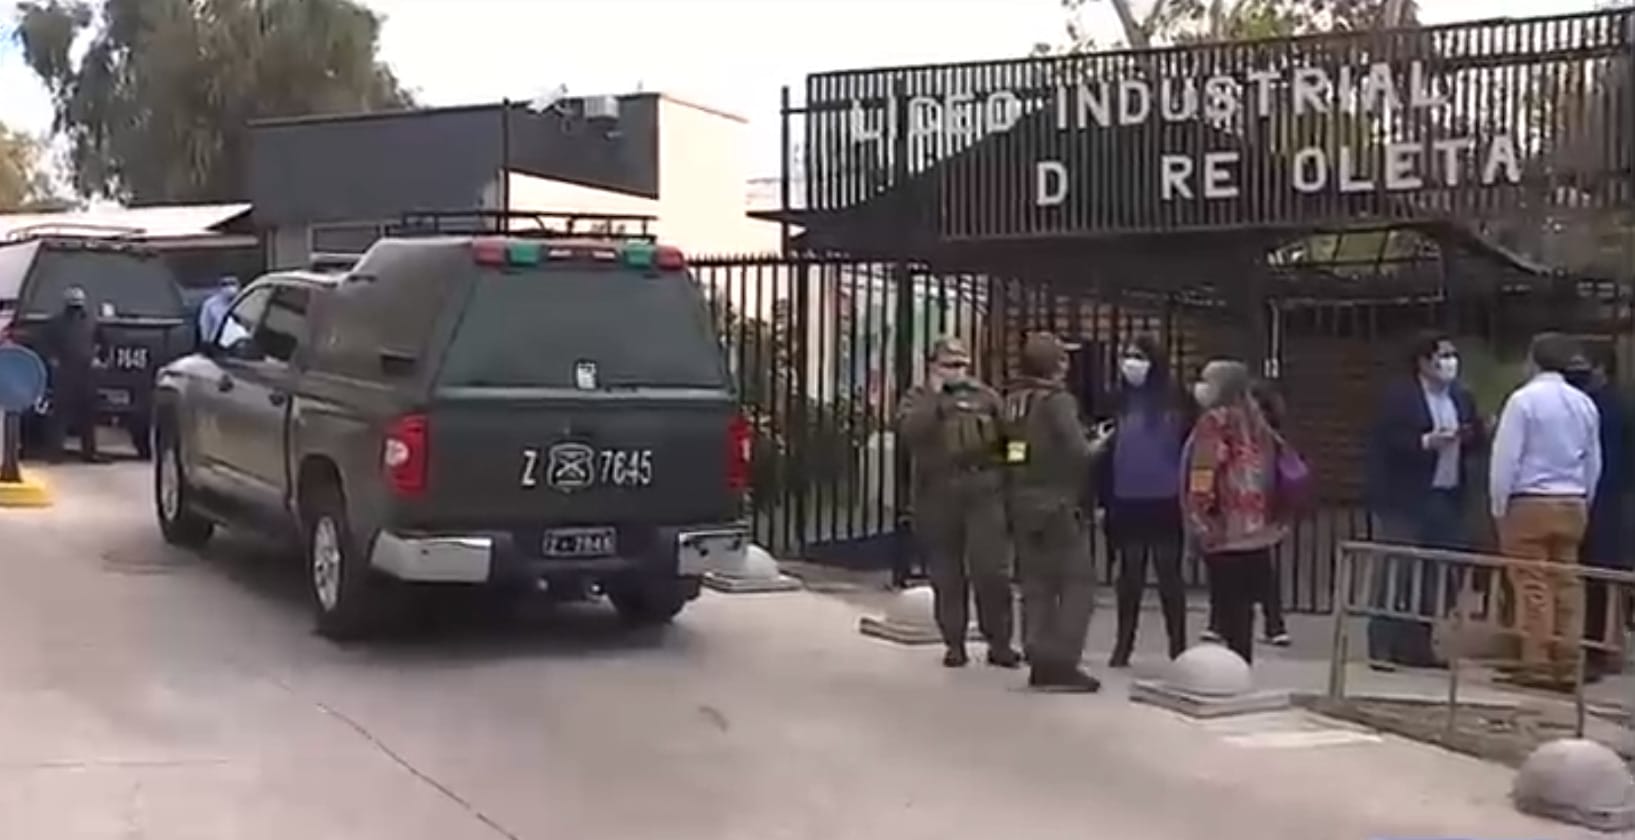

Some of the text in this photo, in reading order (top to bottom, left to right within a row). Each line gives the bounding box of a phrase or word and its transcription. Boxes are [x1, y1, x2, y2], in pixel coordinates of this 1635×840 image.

[1056, 60, 1452, 129] INDUSTRIAL
[522, 450, 652, 485] Z 7645
